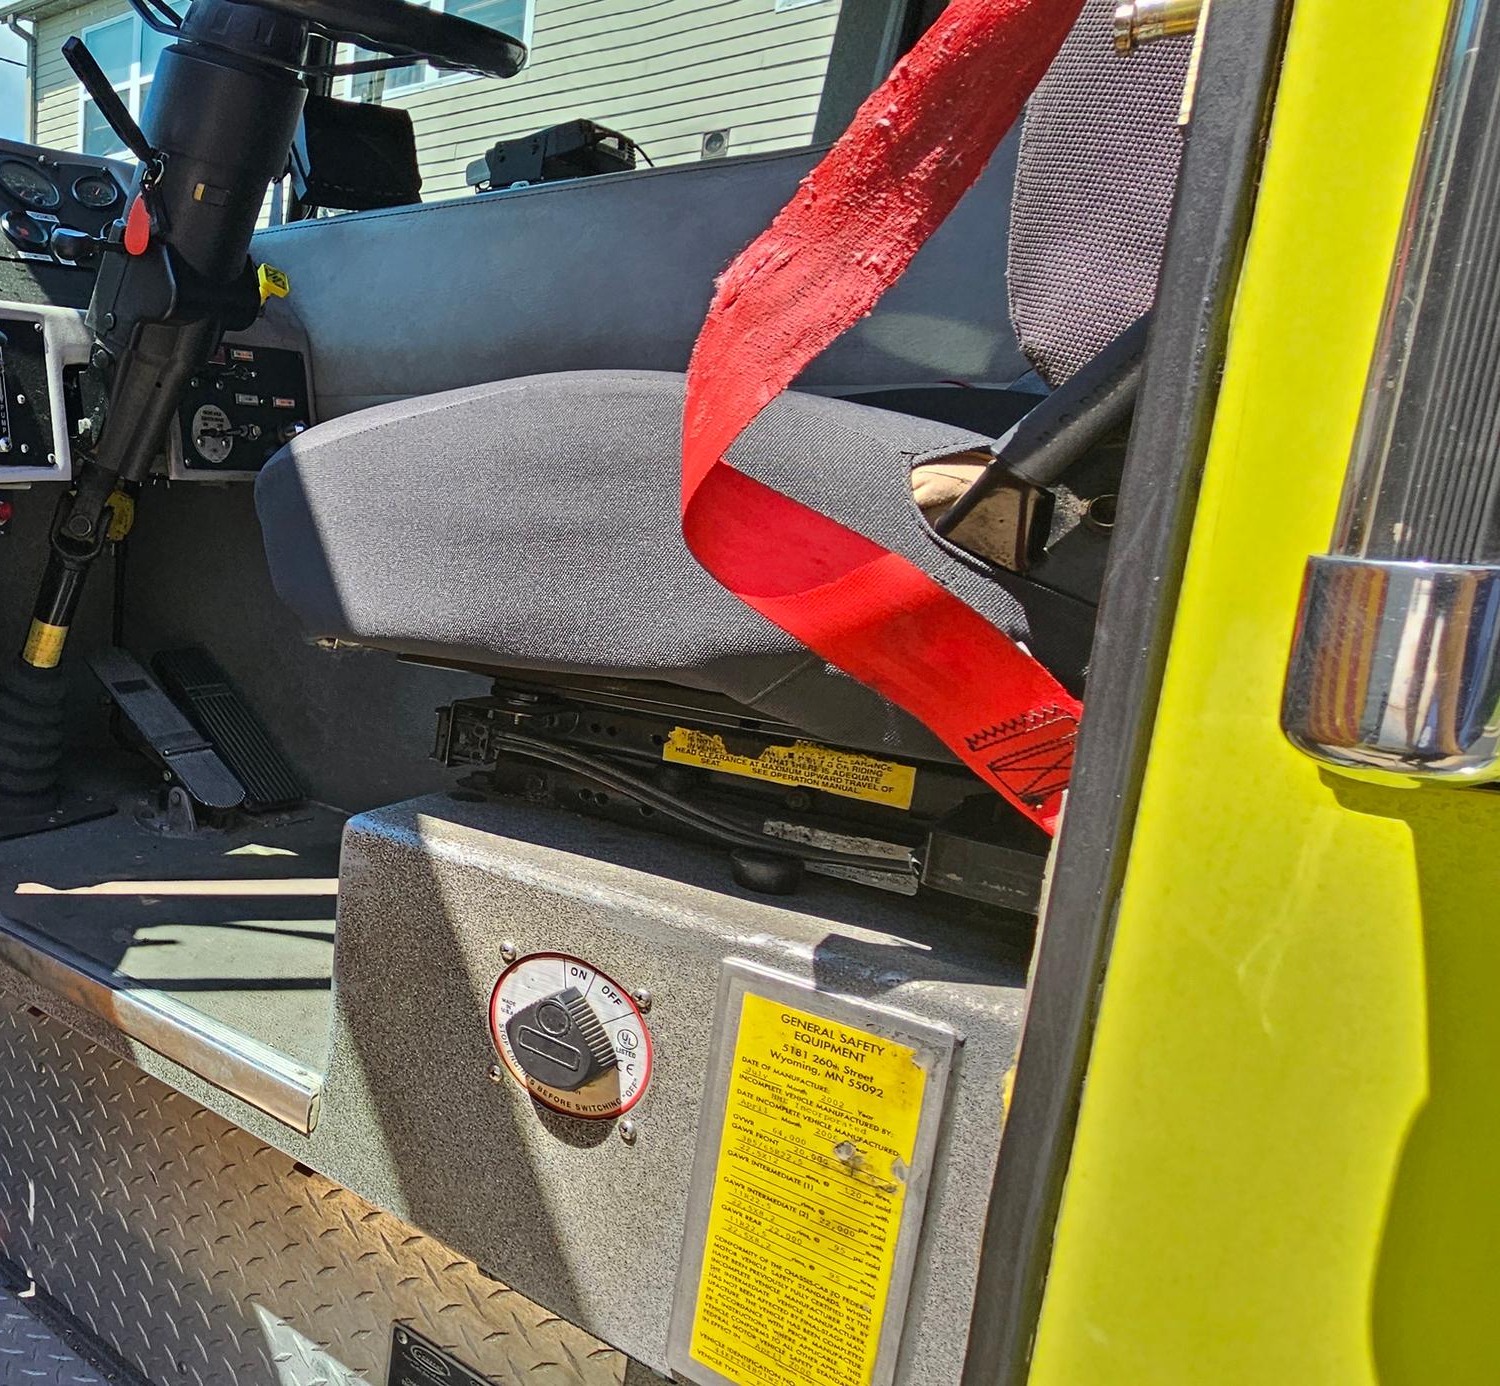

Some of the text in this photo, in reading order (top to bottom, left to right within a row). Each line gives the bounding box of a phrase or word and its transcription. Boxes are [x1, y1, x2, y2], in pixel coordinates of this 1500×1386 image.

[675, 746, 696, 755] HEAD
[698, 750, 747, 765] CLEARANCE
[761, 762, 802, 775] MAXIMUM
[804, 770, 843, 783] UPWARD
[845, 778, 879, 791] TRAVEL
[880, 785, 894, 793] OF
[751, 767, 767, 775] SEE
[769, 771, 819, 786] OPERATION
[832, 769, 881, 784] ADEQUATE
[851, 765, 884, 777] RIDING
[570, 967, 587, 980] ON
[601, 985, 623, 1006] OFF
[615, 1047, 637, 1059] LISTED
[780, 1012, 885, 1057] GENERAL SAFETY
[794, 1030, 866, 1064] EQUIPMENT
[499, 1023, 512, 1050] STOP
[537, 1085, 572, 1108] BEFORE
[575, 1097, 621, 1112] SWITCHING
[741, 1055, 758, 1067] DATE
[760, 1063, 771, 1072] OF
[768, 1048, 884, 1098] Wyoming, MN 55092
[781, 1043, 874, 1083] 5181 260th Street
[732, 1112, 755, 1126] GVWR
[736, 1088, 831, 1130] DATE INCOMPLETE VEHICLE
[738, 1073, 782, 1094] INCOMPLETE
[784, 1090, 813, 1106] VEHICLE
[815, 1102, 879, 1132] MANUFACTURED
[781, 1116, 802, 1129] Month
[786, 1082, 808, 1096] Month
[820, 1094, 844, 1109] 2002
[857, 1109, 874, 1121] Year
[731, 1121, 779, 1146] GAWR FRONT
[727, 1149, 814, 1191] GAWR INTERMEDIATE (1)
[720, 1202, 742, 1217] GAWR
[744, 1214, 762, 1226] REAR
[723, 1176, 745, 1190] GAWR
[747, 1186, 797, 1214] INTERMEDIATE
[798, 1209, 809, 1220] (2)
[713, 1241, 737, 1257] MOTOR
[741, 1254, 767, 1271] VEHICLE
[770, 1269, 794, 1285] SAFETY
[845, 1306, 872, 1322] WHICH
[714, 1234, 757, 1259] CONFORMITY
[759, 1255, 768, 1263] OF
[770, 1261, 782, 1271] THE
[830, 1290, 840, 1299] TO
[708, 1271, 721, 1281] HAS
[722, 1278, 737, 1289] NOT
[739, 1286, 755, 1298] BEEN
[757, 1295, 789, 1315] AFFECTED
[790, 1312, 798, 1320] BY
[709, 1263, 720, 1273] THE
[723, 1270, 770, 1298] INTERMEDIATE
[776, 1297, 803, 1315] VEHICLE
[710, 1256, 868, 1338] INCOMPLETE VEHICLE MANUFACTURER OR BY
[711, 1249, 870, 1331] HAVE BEEN PREVIOUSLY FULLY CERTIFIED BY THE
[702, 1315, 709, 1323] IN
[710, 1320, 731, 1335] EFFECT
[732, 1331, 740, 1339] IN
[717, 1291, 763, 1319] ACCORDANCE
[766, 1317, 784, 1330] WITH
[787, 1327, 807, 1341] PRIOR
[745, 1297, 756, 1306] THE
[758, 1304, 784, 1321] VEHICLE
[786, 1318, 800, 1330] HAS
[802, 1327, 820, 1340] BEEN
[821, 1337, 864, 1363] COMPLETED
[696, 1348, 722, 1367] VEHICLE
[699, 1331, 725, 1350] VEHICLE
[726, 1345, 781, 1379] IDENTIFICATION
[703, 1308, 729, 1326] FEDERAL
[731, 1323, 756, 1339] MOTOR
[759, 1337, 785, 1355] VEHICLE
[788, 1353, 813, 1369] SAFETY
[704, 1301, 860, 1386] VEHICLE CONFORMS TO ALL OTHER APPLICABLE
[772, 1327, 796, 1344] WHERE
[846, 1366, 862, 1378] THIS
